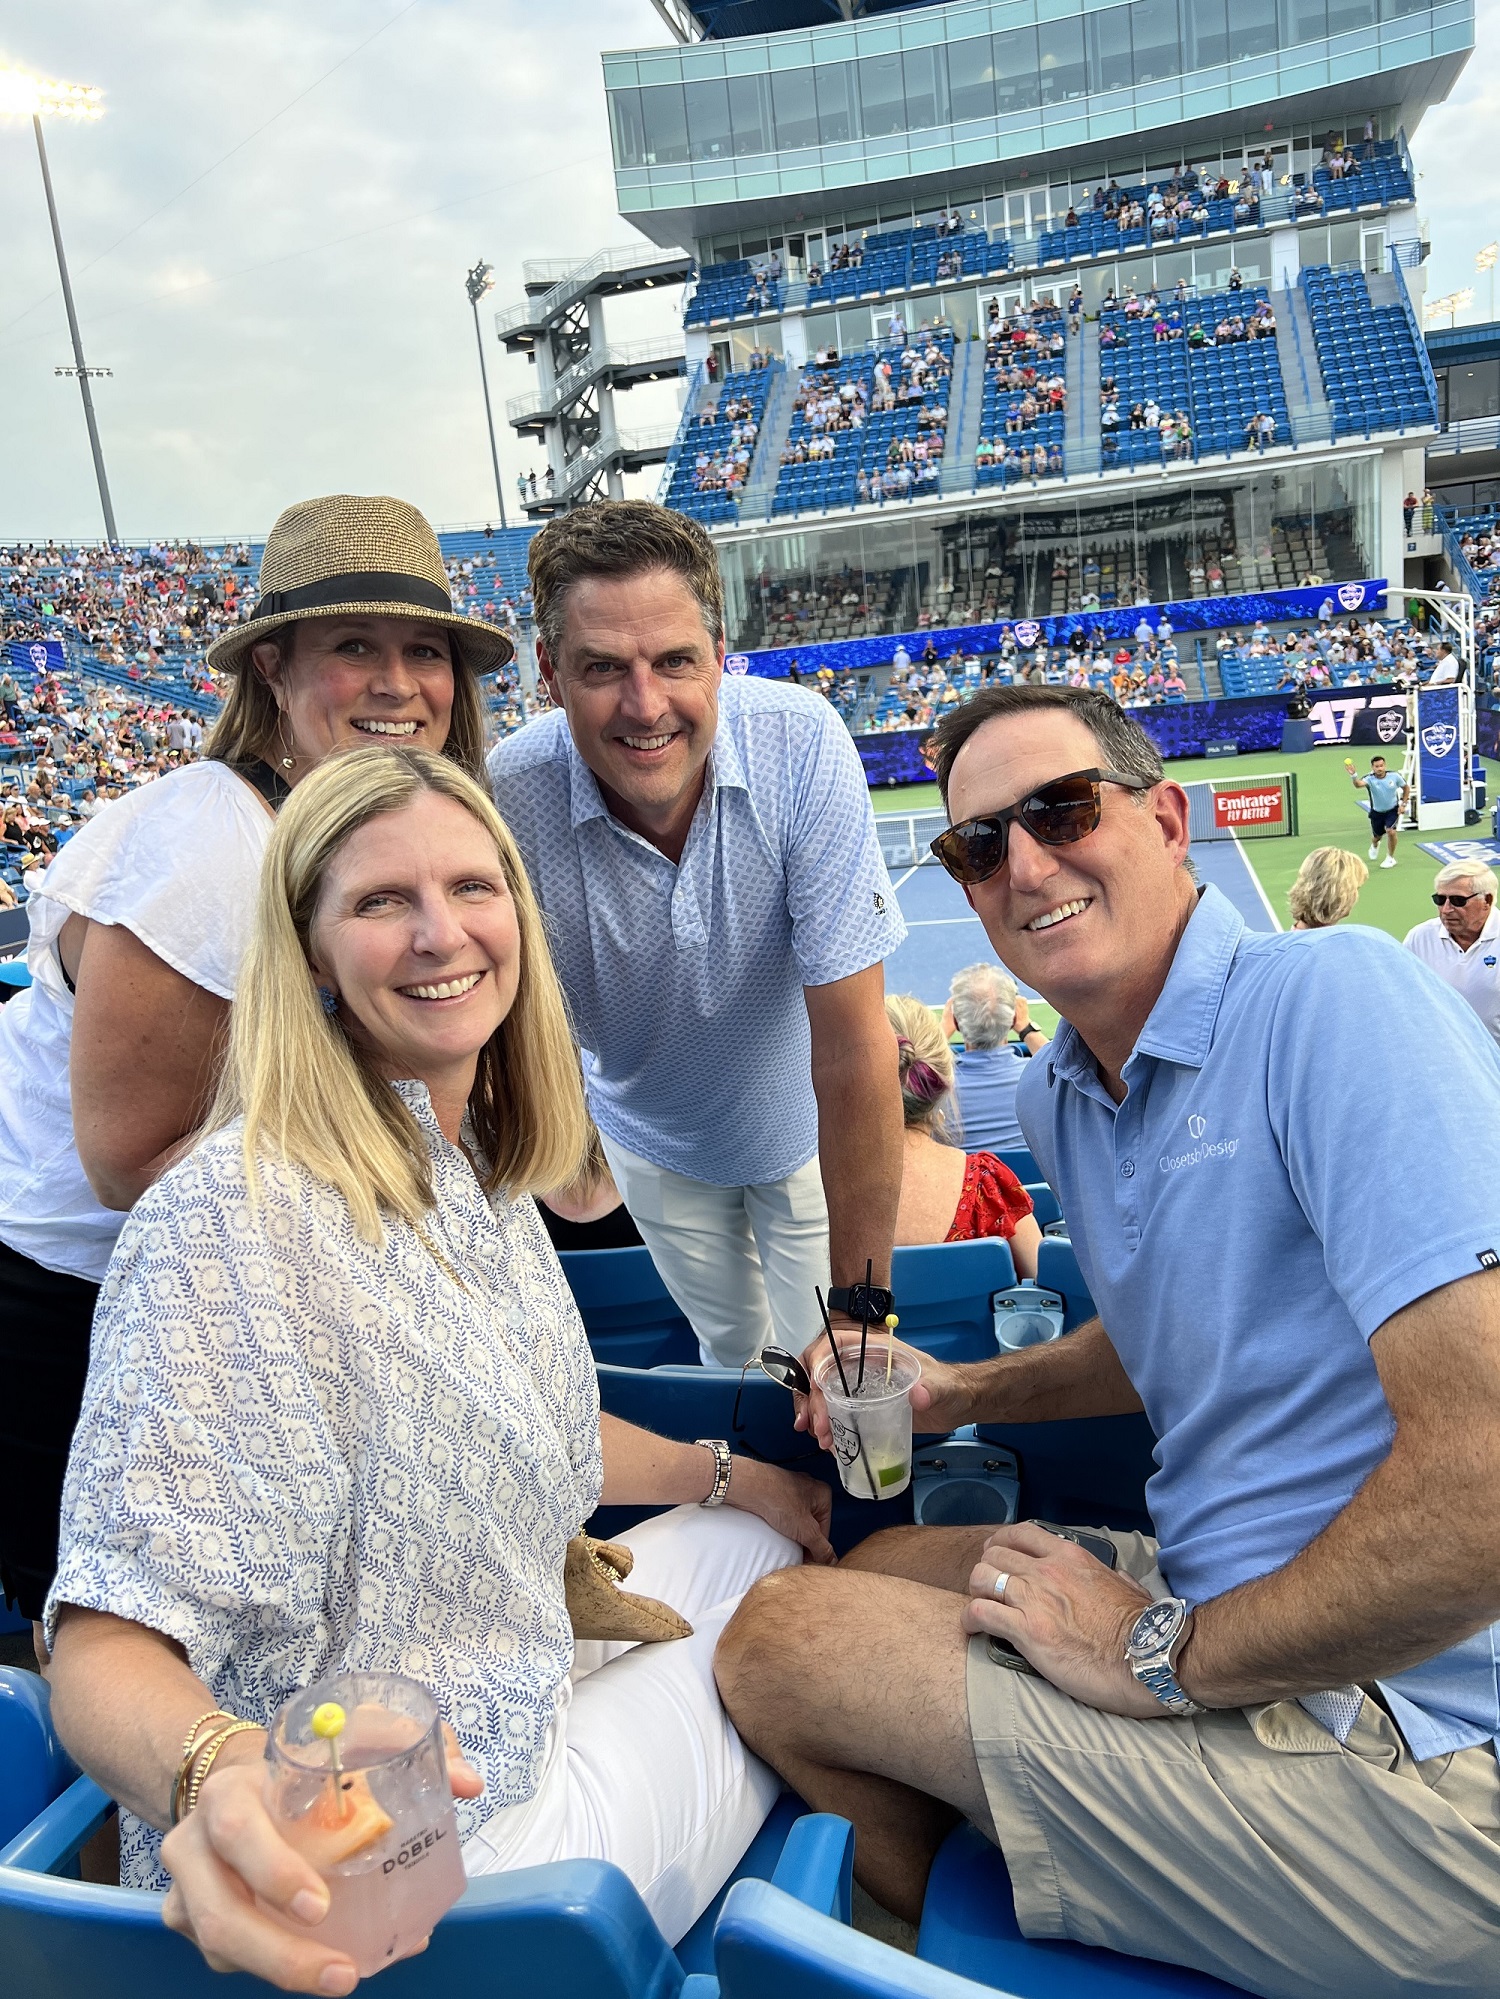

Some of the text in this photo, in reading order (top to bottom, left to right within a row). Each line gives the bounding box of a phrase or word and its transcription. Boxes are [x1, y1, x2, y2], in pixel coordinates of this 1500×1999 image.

[1217, 794, 1279, 811] Emirates
[1227, 806, 1270, 821] FLY BETTER
[382, 1828, 448, 1875] DOBEL
